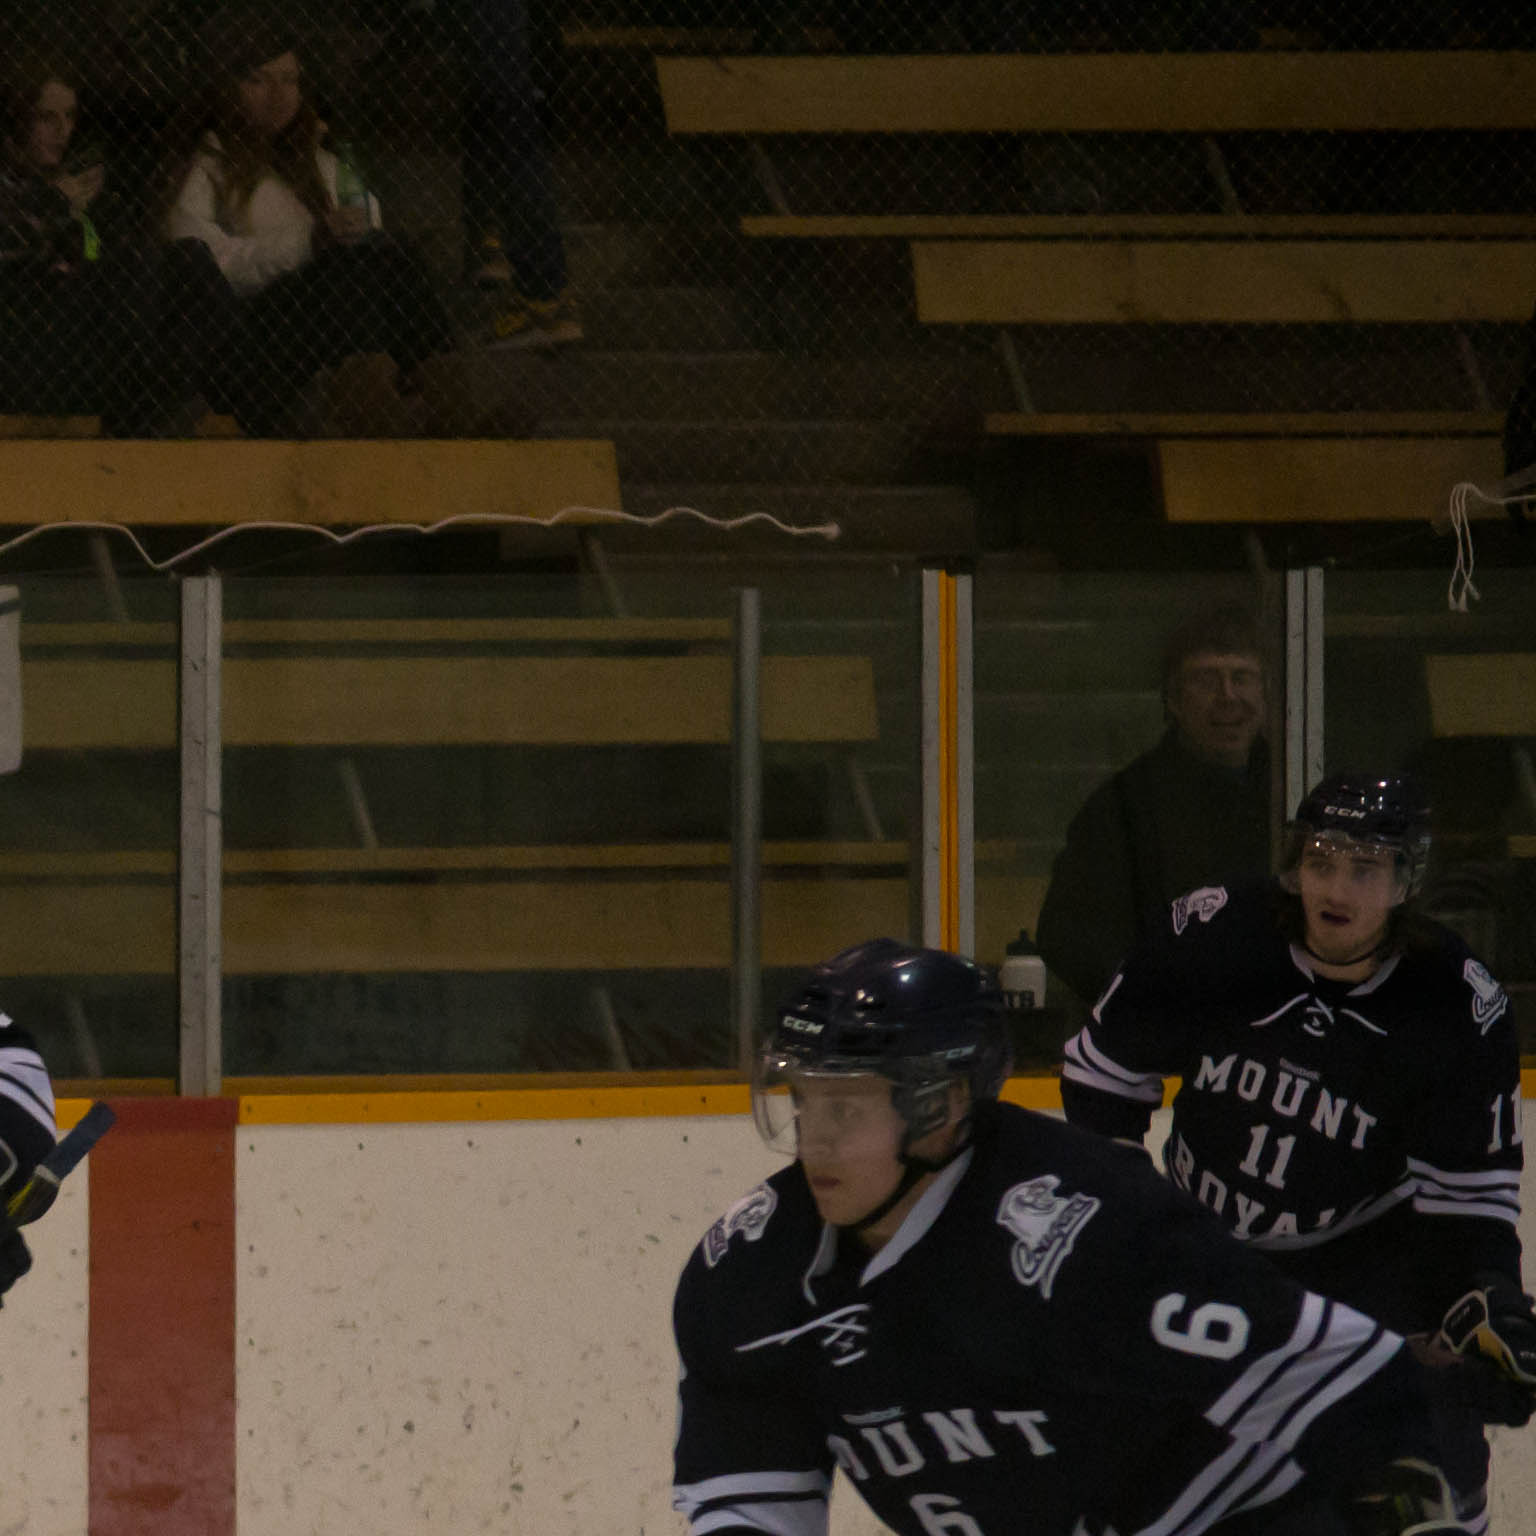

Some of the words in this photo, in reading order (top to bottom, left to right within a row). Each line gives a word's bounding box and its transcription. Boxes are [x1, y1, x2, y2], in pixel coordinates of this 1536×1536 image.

[782, 1015, 824, 1034] CCM
[1193, 1053, 1378, 1151] MOUNT
[1239, 1123, 1296, 1191] 11
[1150, 1292, 1251, 1362] 6
